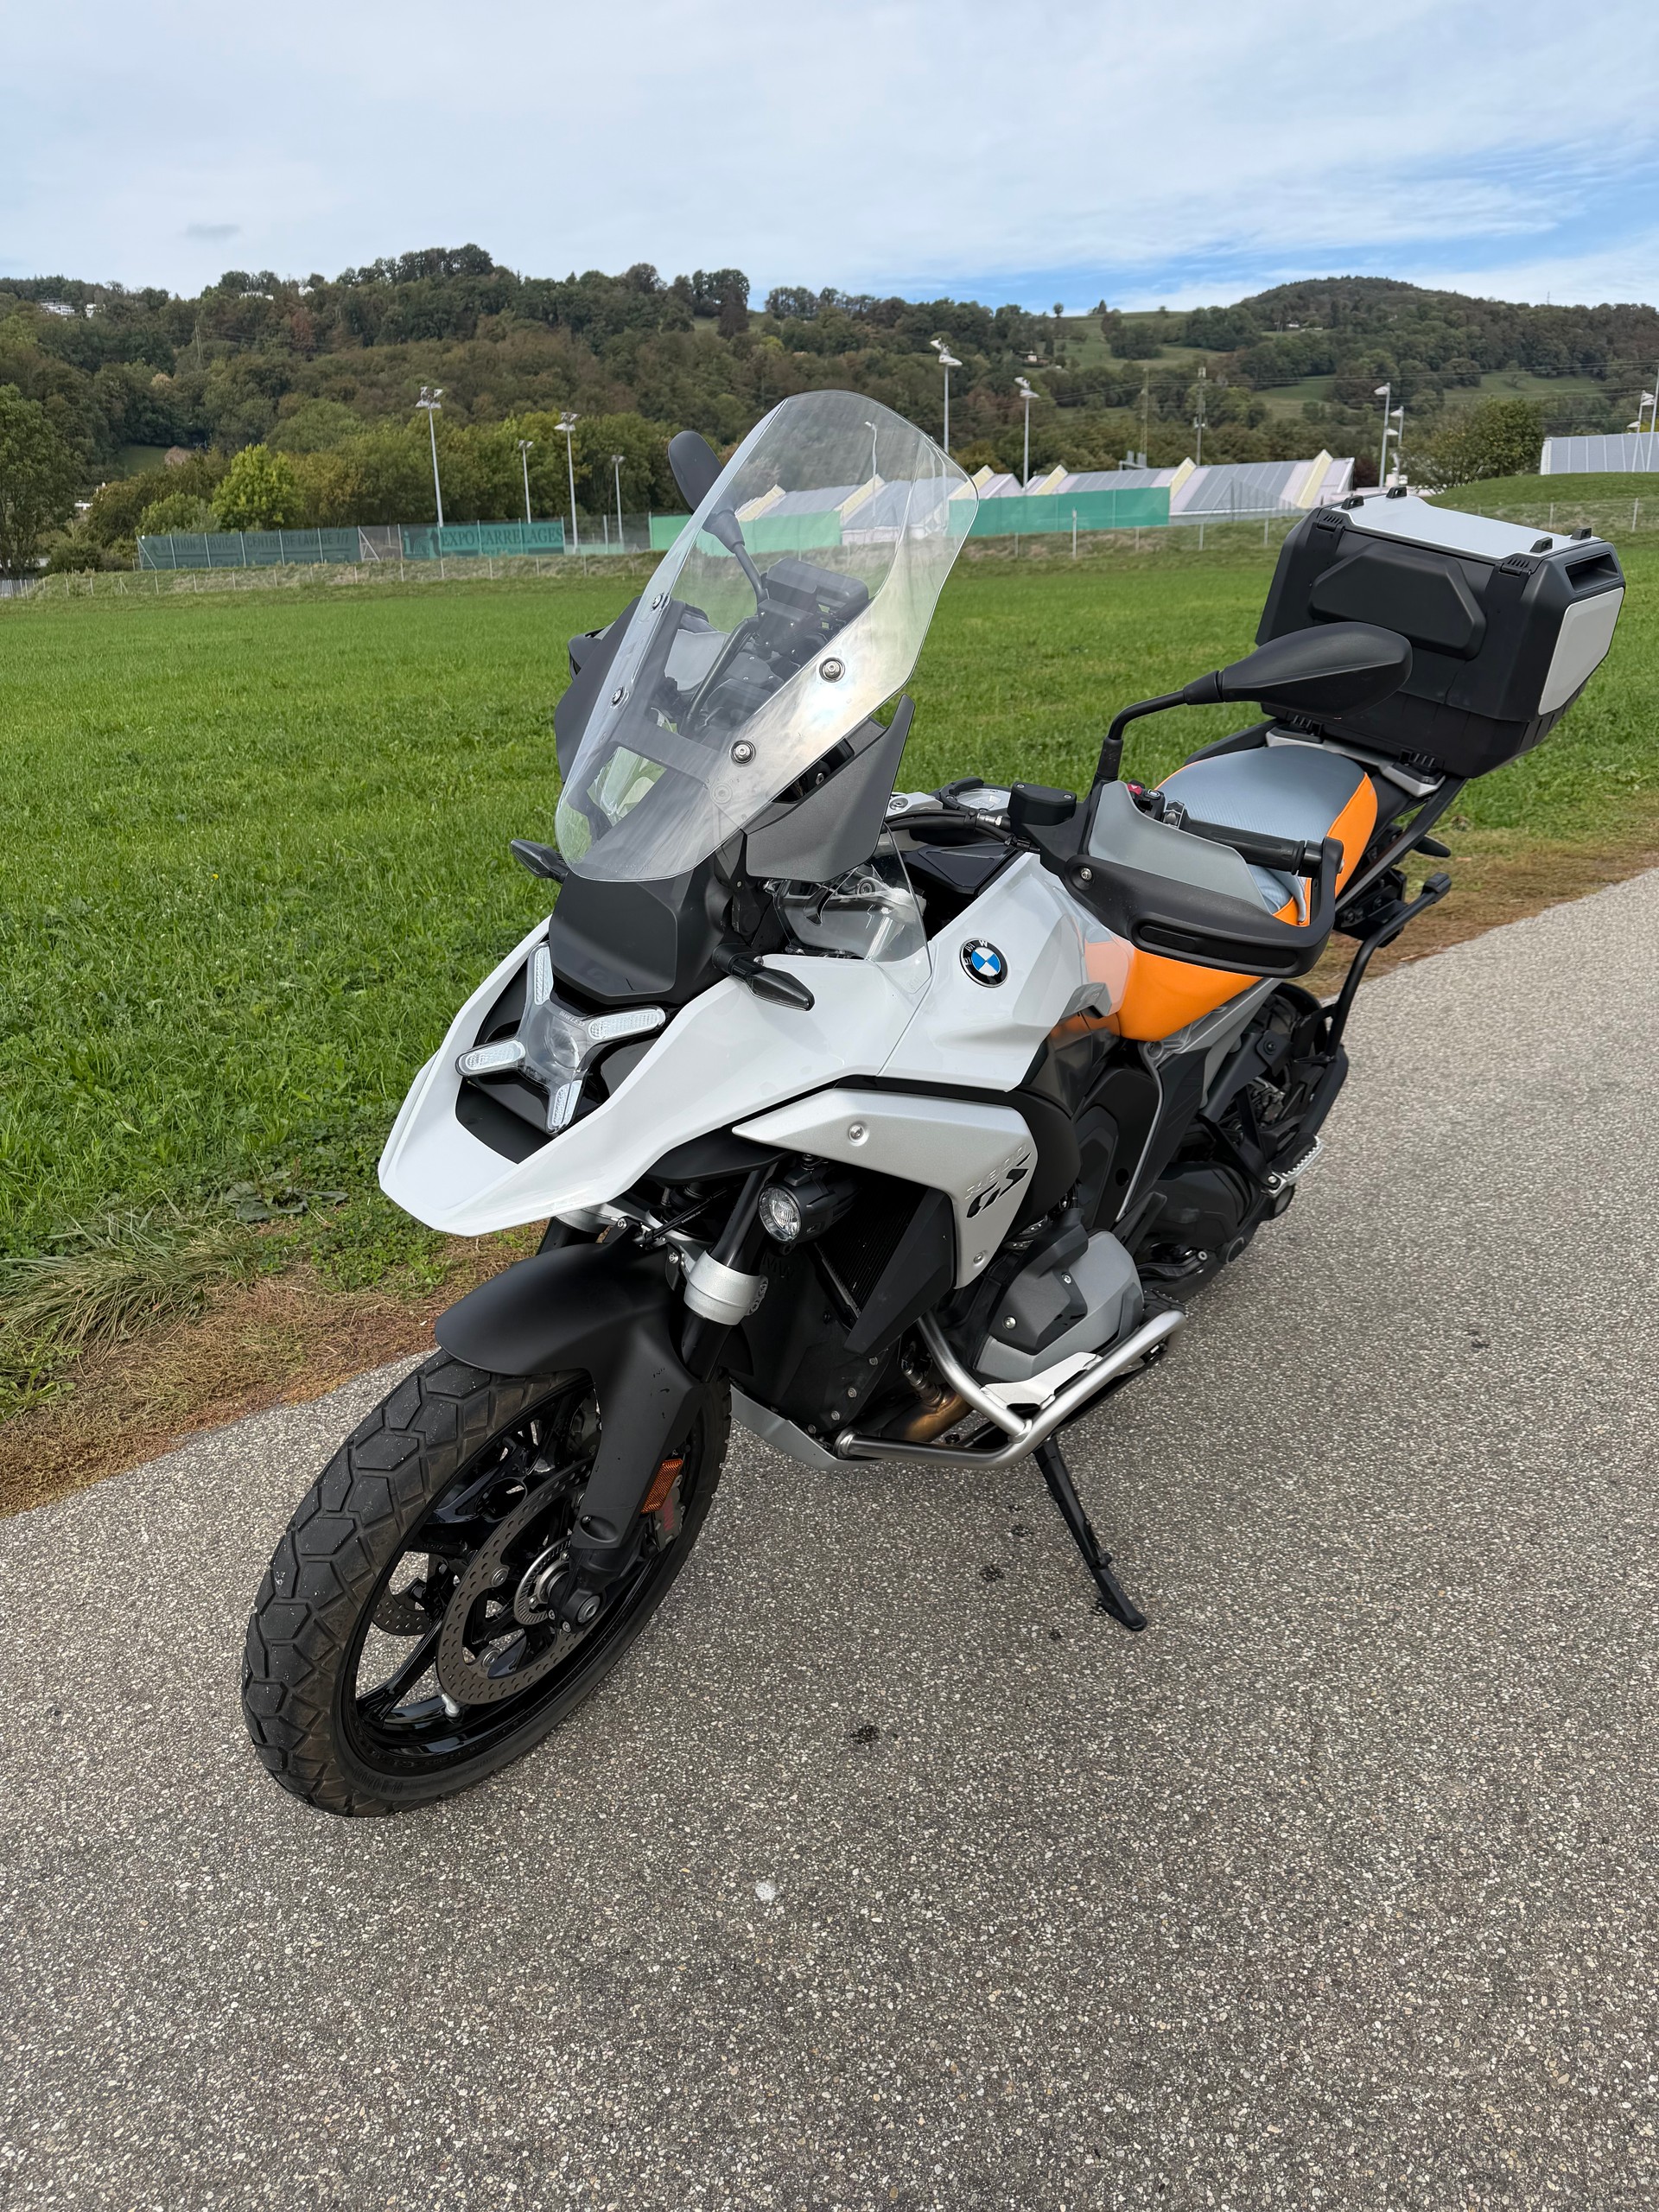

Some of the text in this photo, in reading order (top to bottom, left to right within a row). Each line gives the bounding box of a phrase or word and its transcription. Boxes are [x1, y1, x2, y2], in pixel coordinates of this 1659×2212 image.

[442, 530, 474, 547] EXPO
[477, 527, 563, 544] CARRELAGES
[963, 939, 988, 966] BMW
[966, 1151, 1033, 1218] GS
